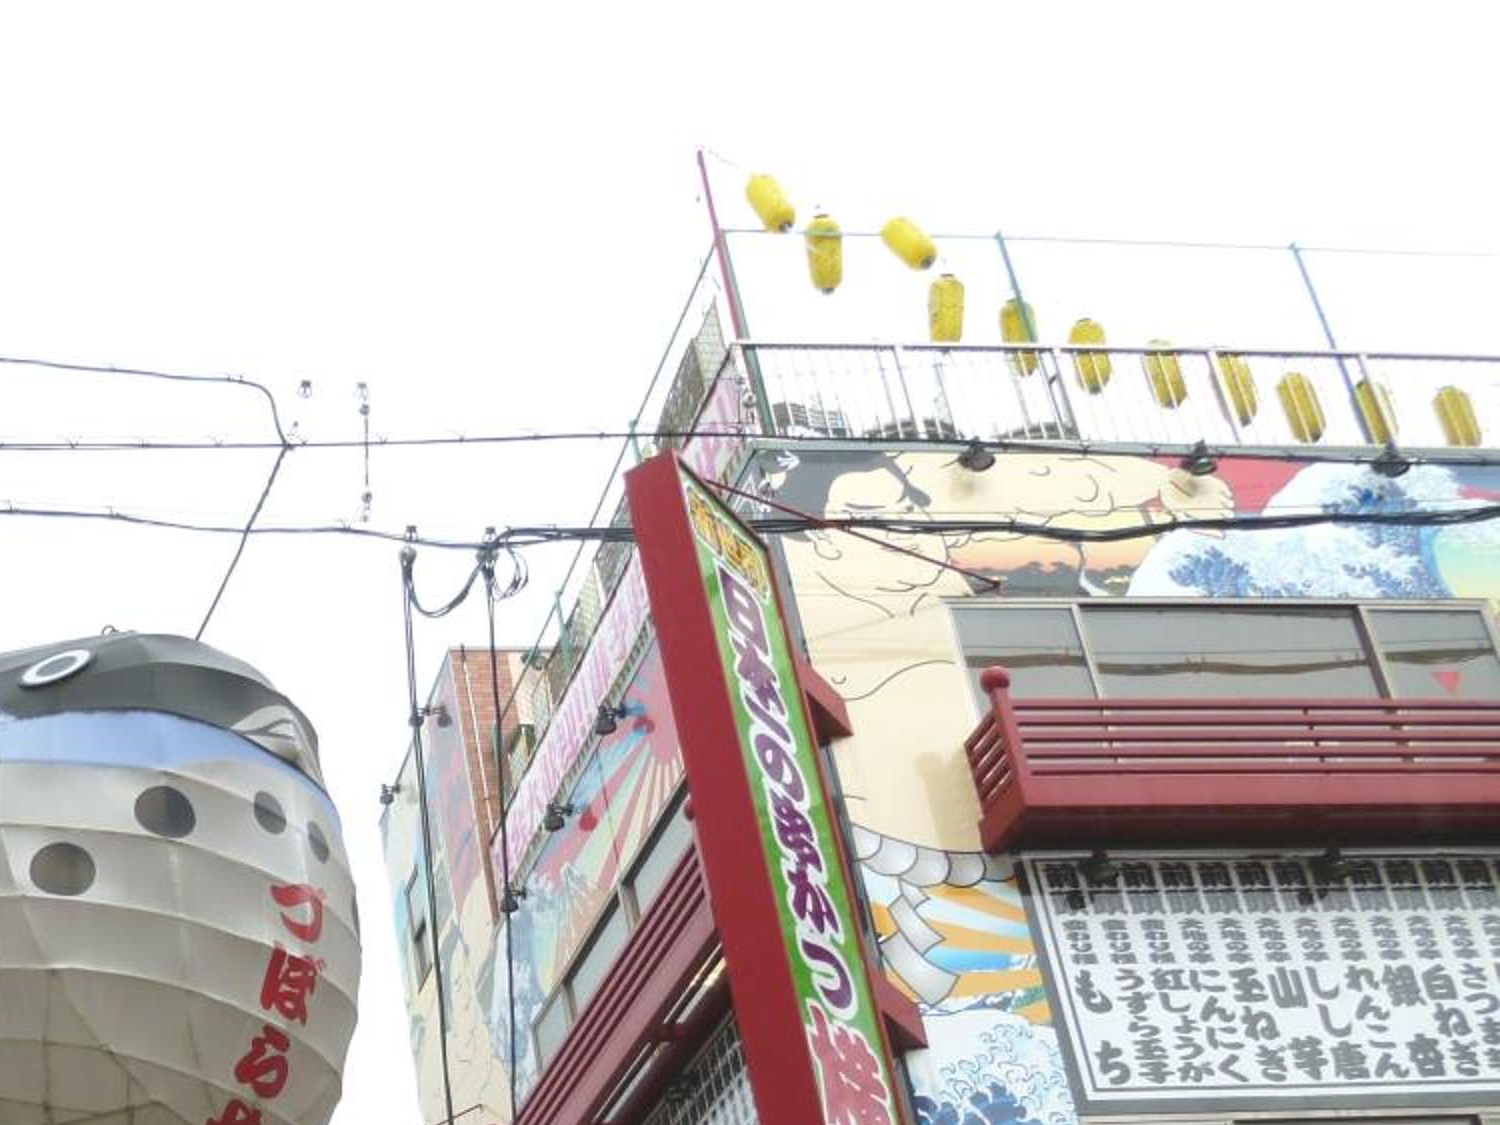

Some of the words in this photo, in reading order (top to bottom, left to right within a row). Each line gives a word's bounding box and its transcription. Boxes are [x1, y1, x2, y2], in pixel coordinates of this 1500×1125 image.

[717, 565, 857, 1012] 日本一の串かつ
[1075, 969, 1131, 1085] もち
[1148, 968, 1215, 1083] 紅しょうが
[1189, 969, 1250, 1083] にんにく
[1229, 967, 1288, 1081] 玉ねぎ
[1267, 966, 1329, 1080] 山芋
[1305, 966, 1370, 1080] しし唐
[1344, 965, 1410, 1078] れんこん
[1422, 964, 1481, 1076] 白ねぎ
